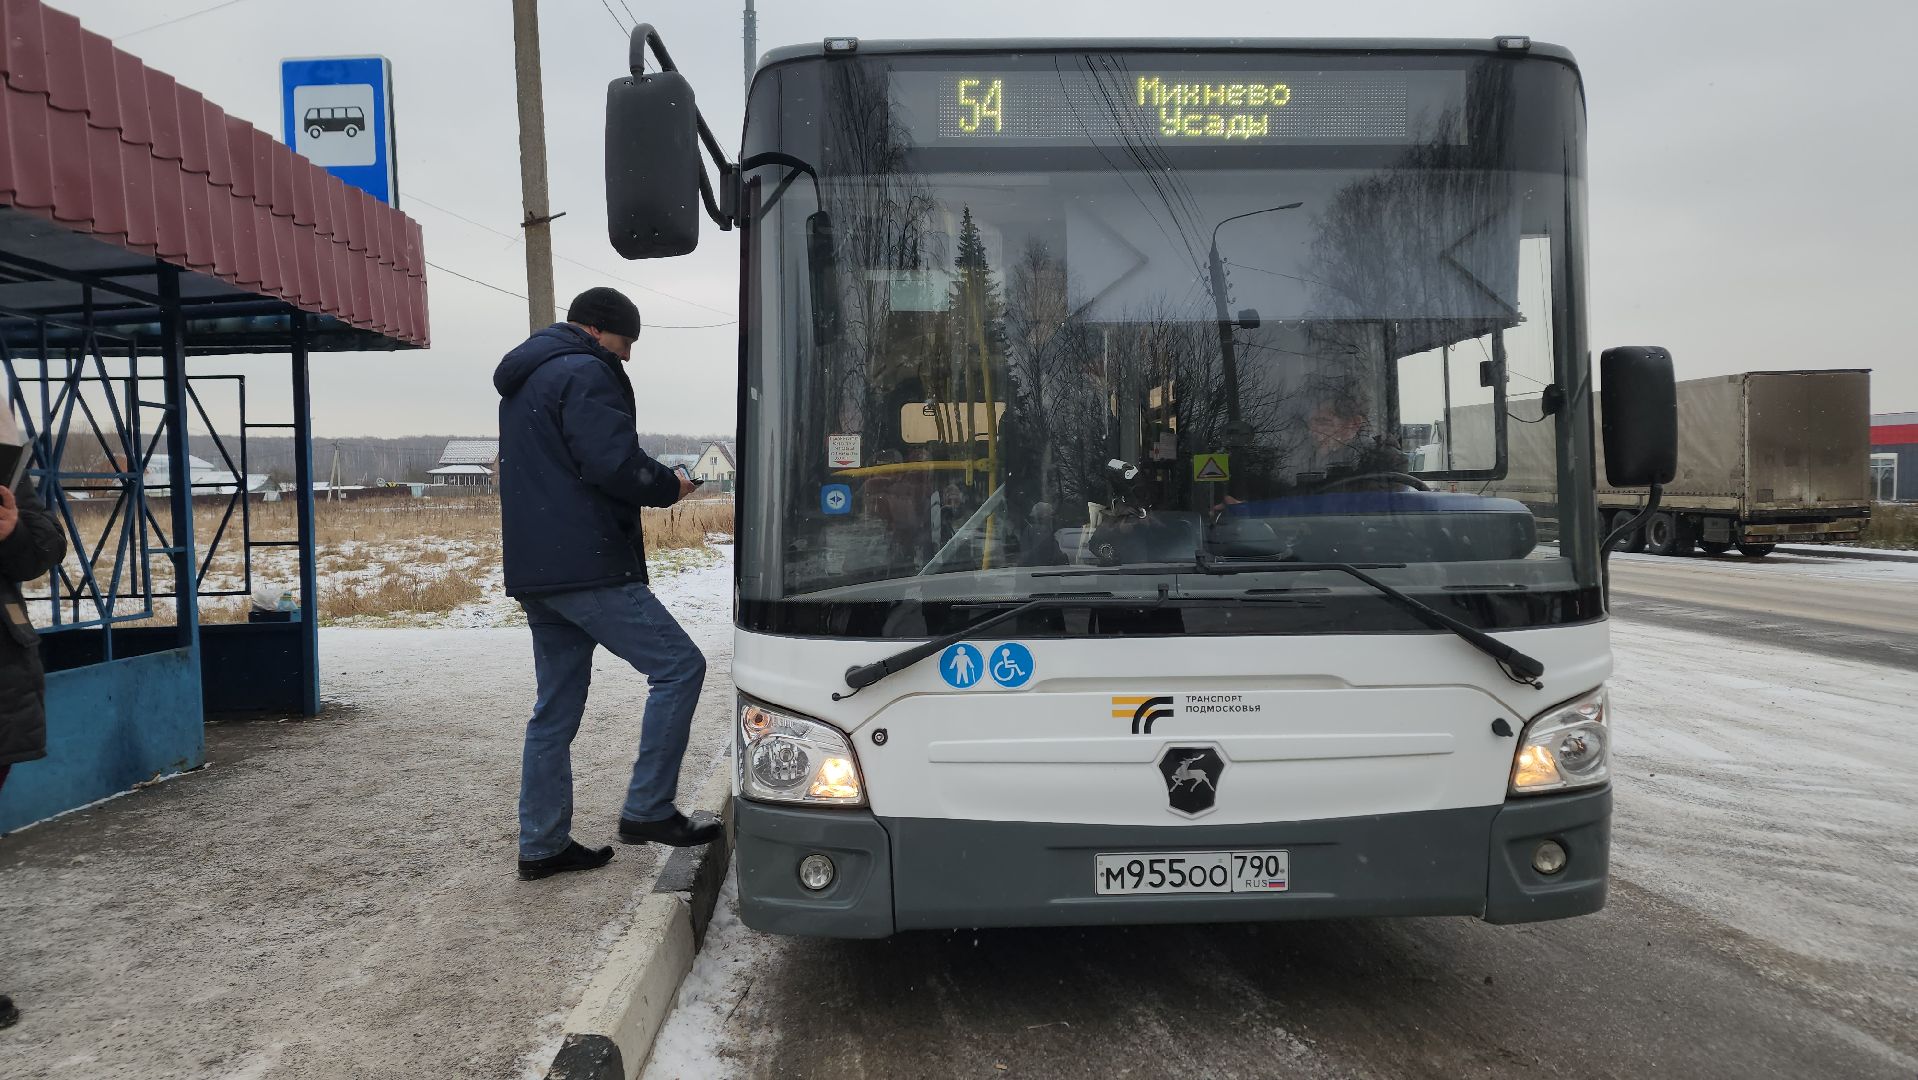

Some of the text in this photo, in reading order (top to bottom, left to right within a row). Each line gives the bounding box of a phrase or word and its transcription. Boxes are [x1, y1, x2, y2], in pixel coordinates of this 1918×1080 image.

[1137, 75, 1291, 107] Михнево
[958, 79, 1003, 133] 54
[1160, 107, 1269, 140] Усады
[1185, 704, 1261, 713] ПОДМОСКОВЬЯ
[1186, 695, 1243, 703] ТРАНСПОРТ
[1233, 855, 1280, 879] 790
[1245, 879, 1268, 888] RUS
